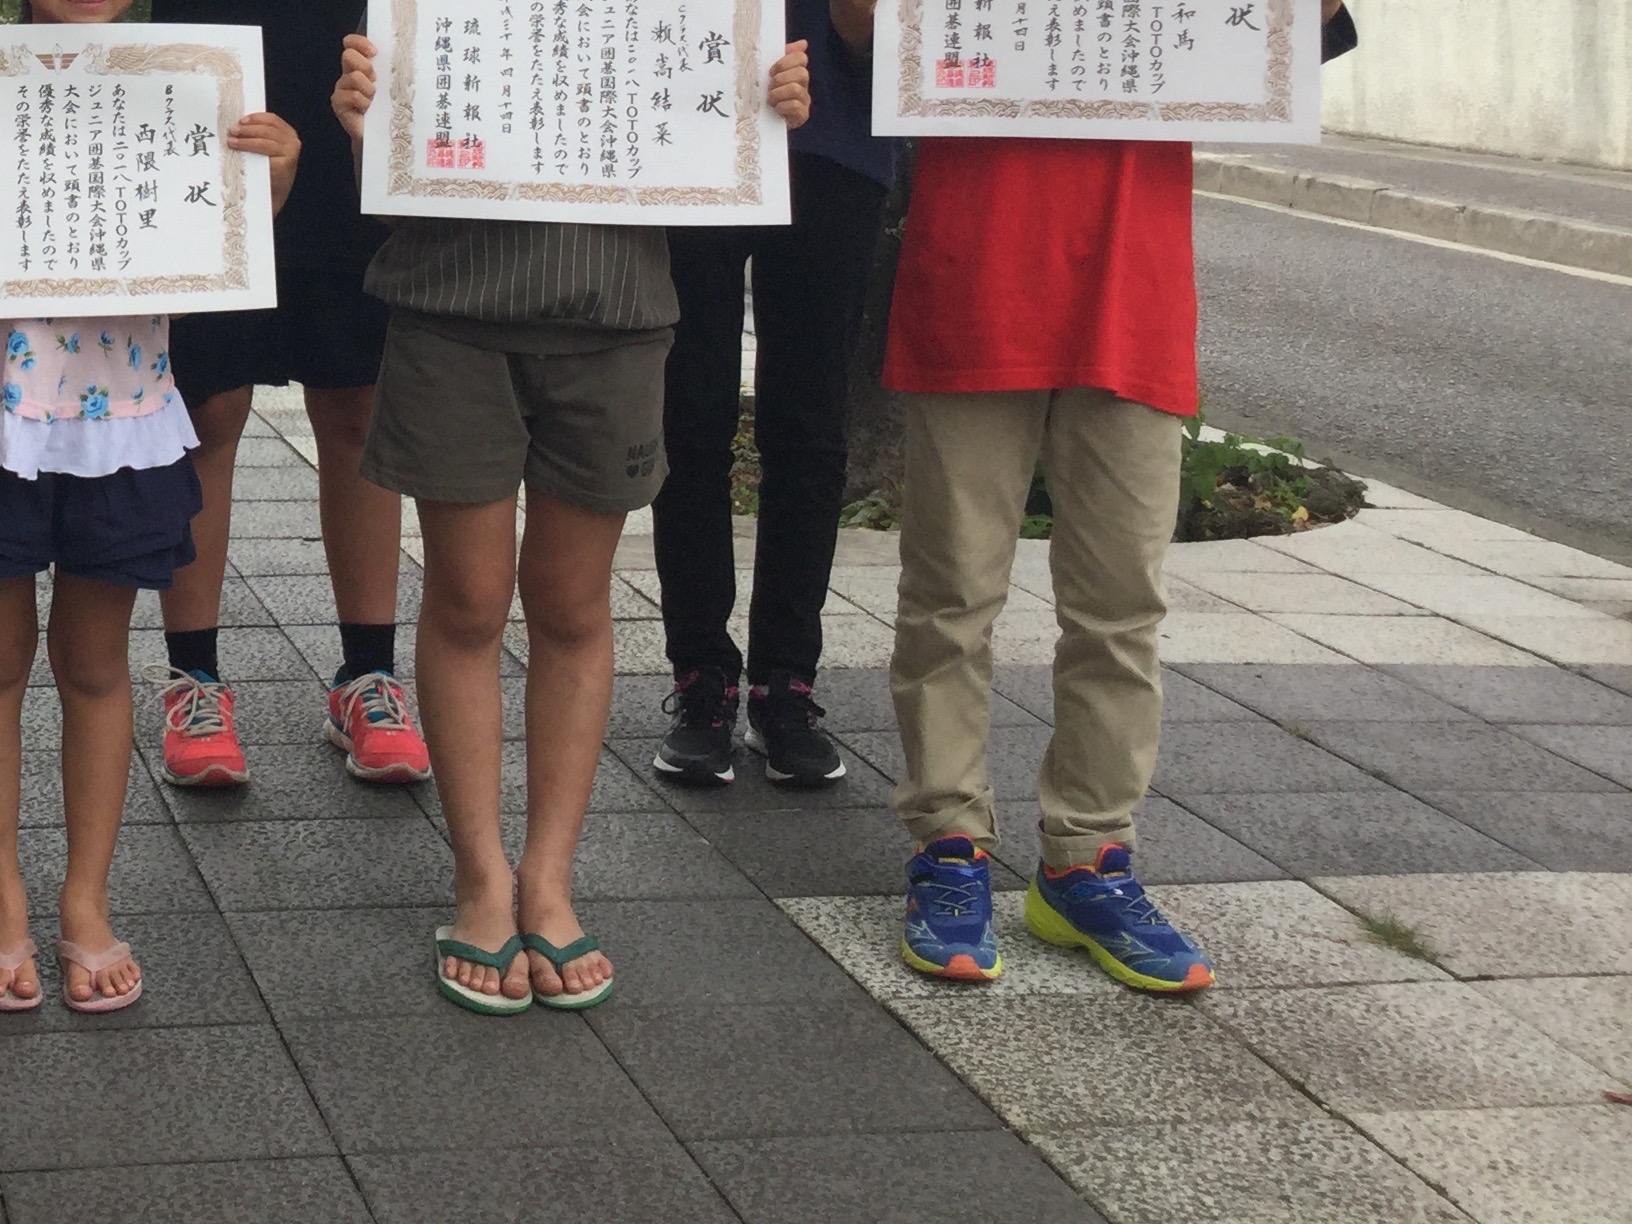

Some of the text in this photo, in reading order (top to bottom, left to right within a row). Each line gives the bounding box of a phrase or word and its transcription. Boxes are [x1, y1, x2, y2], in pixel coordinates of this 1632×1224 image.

[435, 17, 452, 148] 沖縄県囲碁連盟
[463, 18, 480, 148] 琉球新報社
[697, 31, 729, 118] 賞状
[14, 85, 32, 270] その栄誉をたたえ表彰します
[39, 83, 56, 270] 優秀な成績を収めましたので
[62, 84, 80, 269] 大会において頭書のとおり
[88, 85, 106, 270] ジュニア囲碁国際大会沖縄県
[135, 123, 159, 228] 西隈樹里
[184, 123, 217, 206] 賞状
